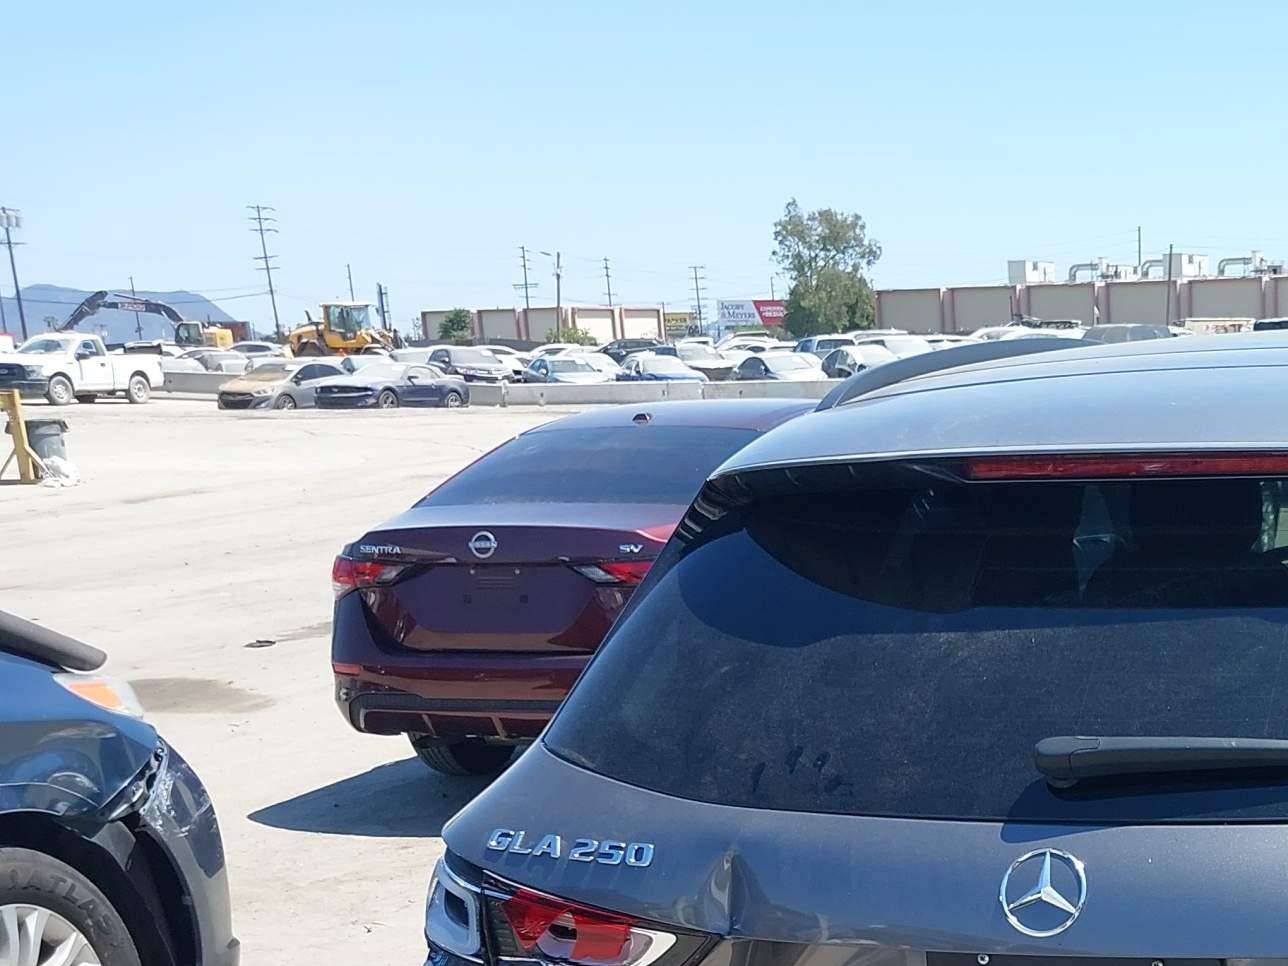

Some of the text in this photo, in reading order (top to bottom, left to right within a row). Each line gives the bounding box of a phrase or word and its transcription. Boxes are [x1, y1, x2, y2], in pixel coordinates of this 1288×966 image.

[360, 544, 401, 554] SENTRA
[619, 543, 643, 553] SV
[486, 828, 655, 867] GLA 250
